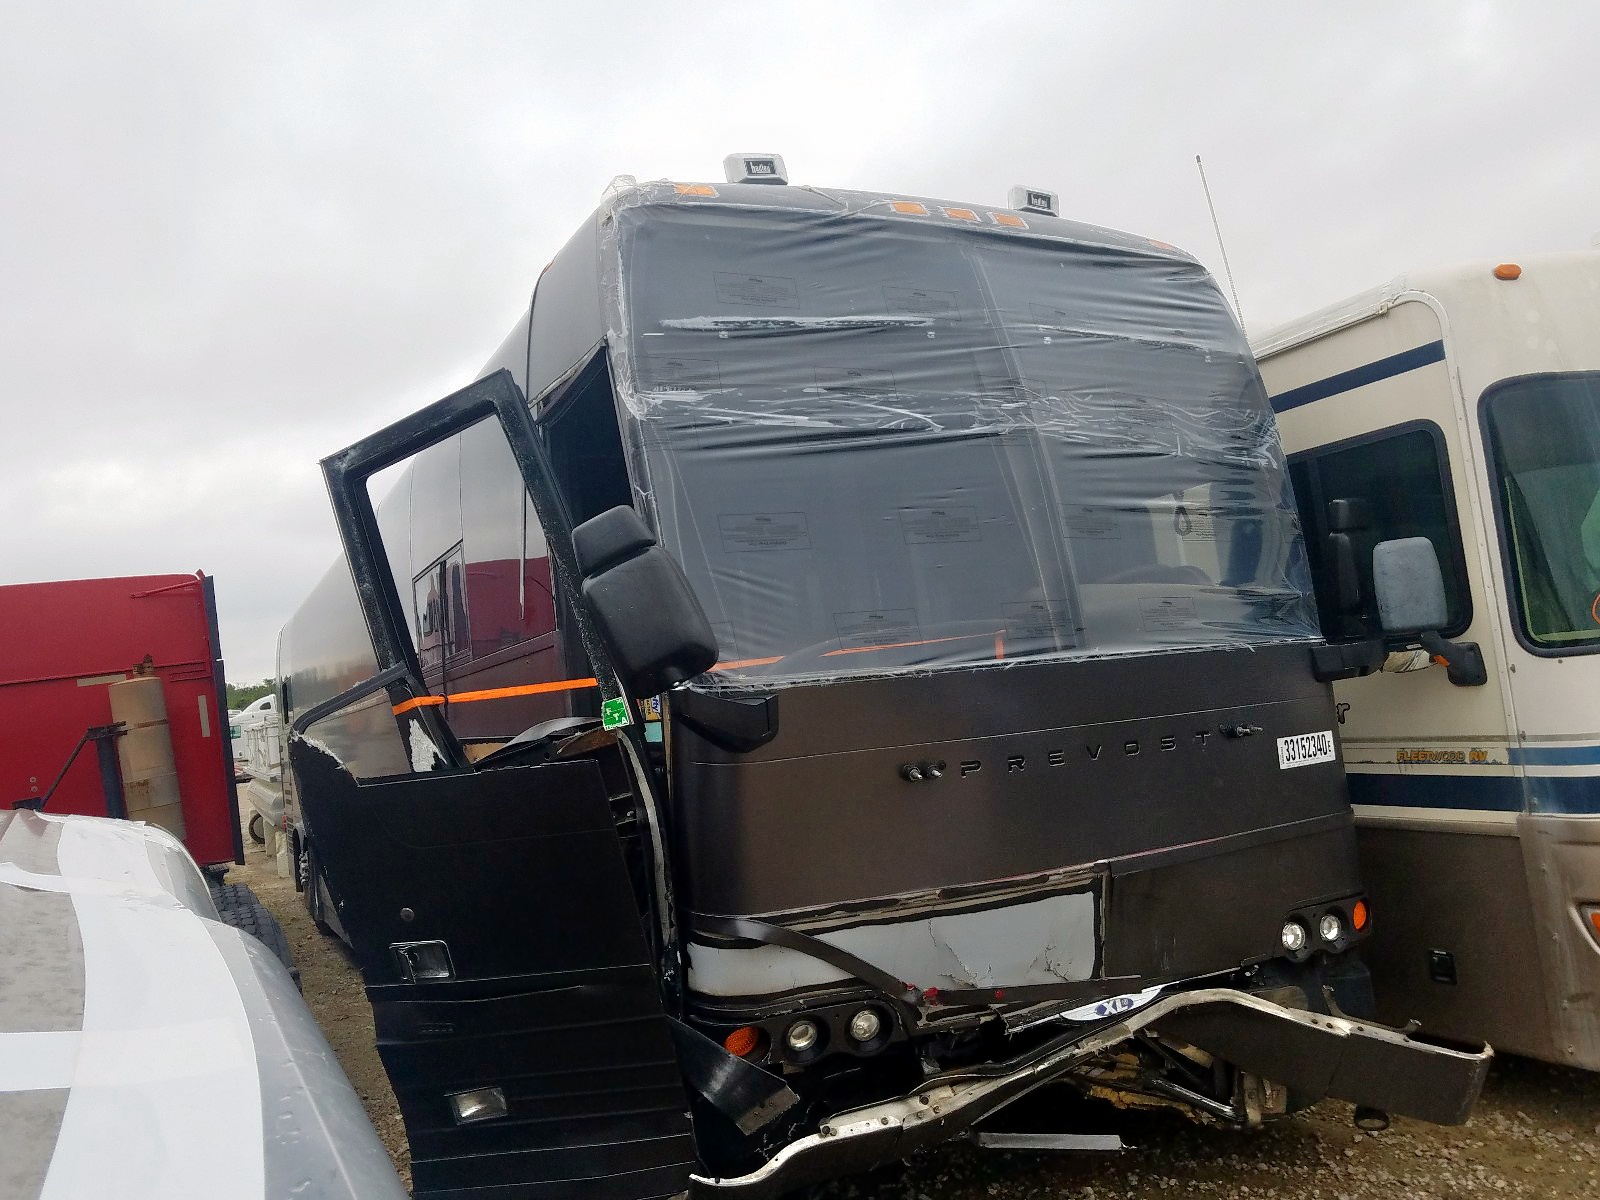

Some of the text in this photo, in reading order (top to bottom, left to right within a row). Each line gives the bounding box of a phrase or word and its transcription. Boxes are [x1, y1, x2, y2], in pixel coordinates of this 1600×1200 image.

[959, 730, 1211, 777] PREVOST
[1284, 733, 1328, 762] 33152340
[1396, 750, 1489, 762] FLEETWOOD RV
